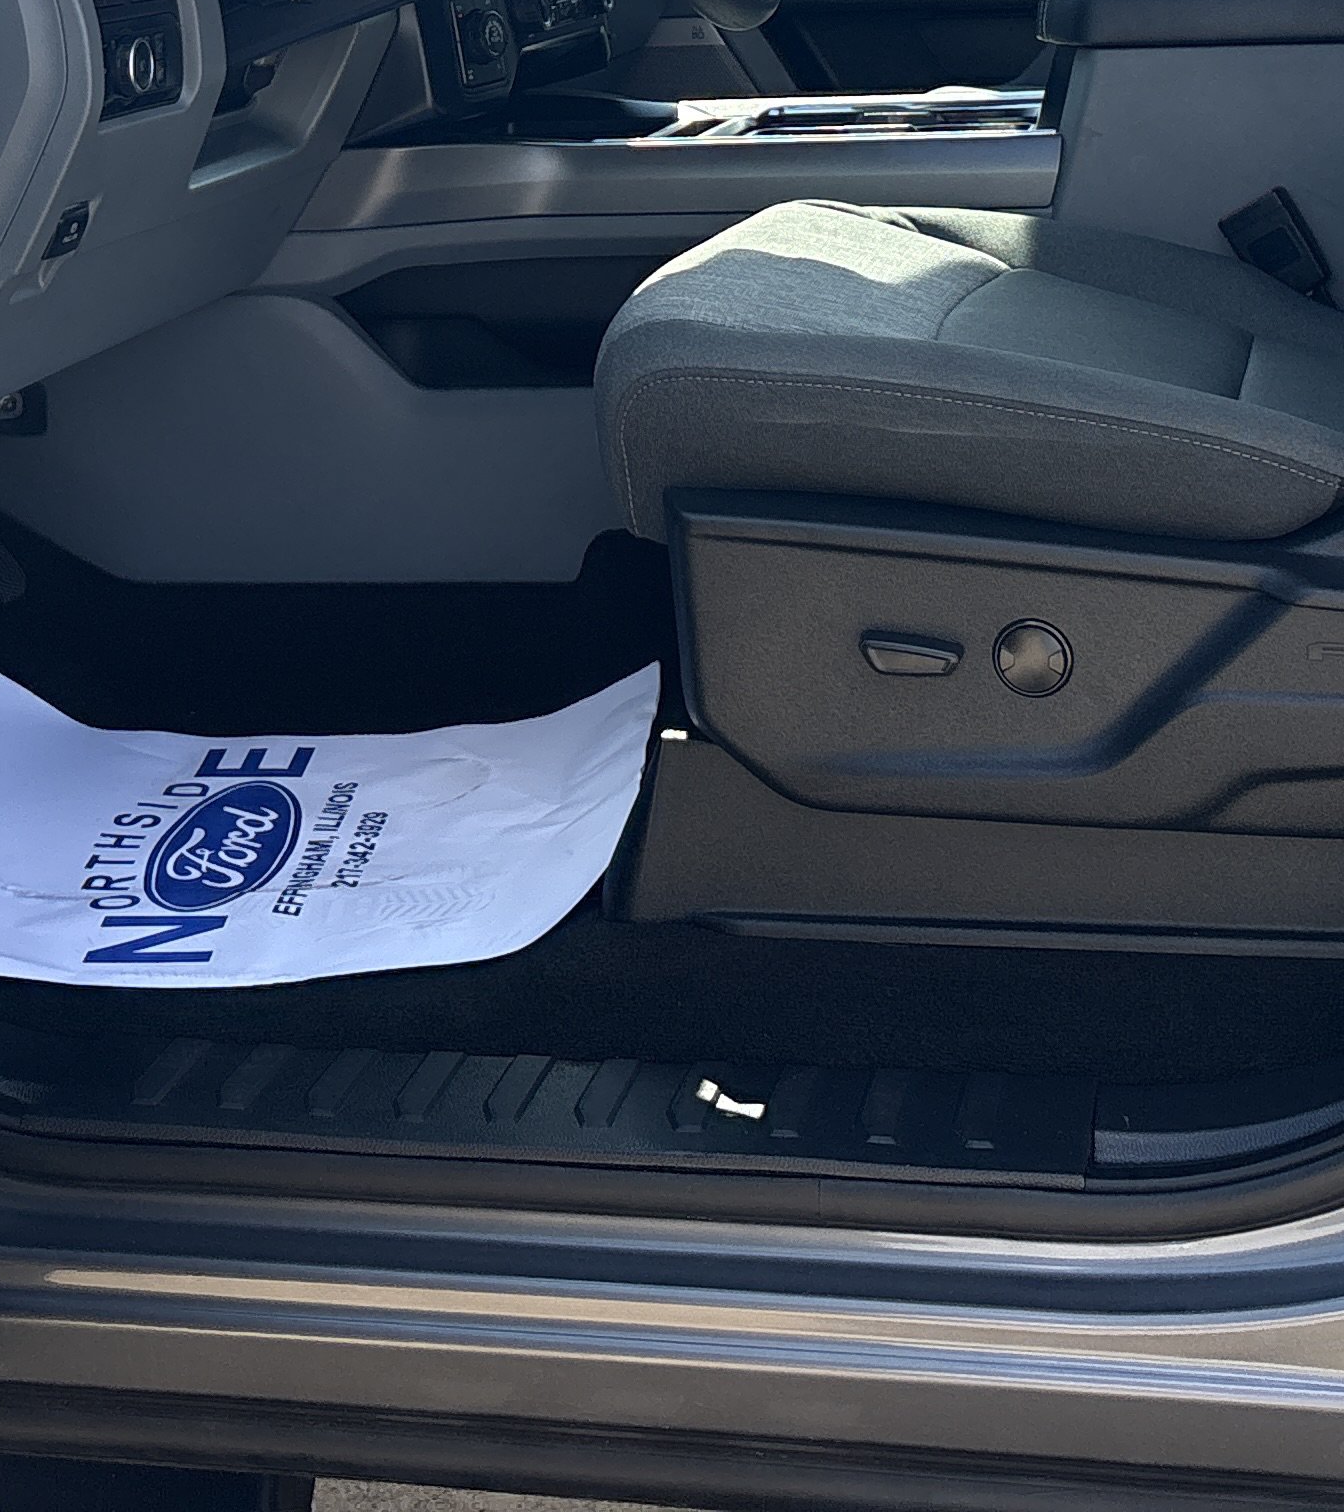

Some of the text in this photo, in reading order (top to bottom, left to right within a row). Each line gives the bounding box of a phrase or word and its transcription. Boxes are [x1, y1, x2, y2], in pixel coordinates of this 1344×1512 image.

[165, 804, 280, 889] Ford
[313, 781, 359, 832] ILLINOIS
[81, 746, 317, 964] NORTHSIDE
[331, 811, 389, 887] 217-342-3929
